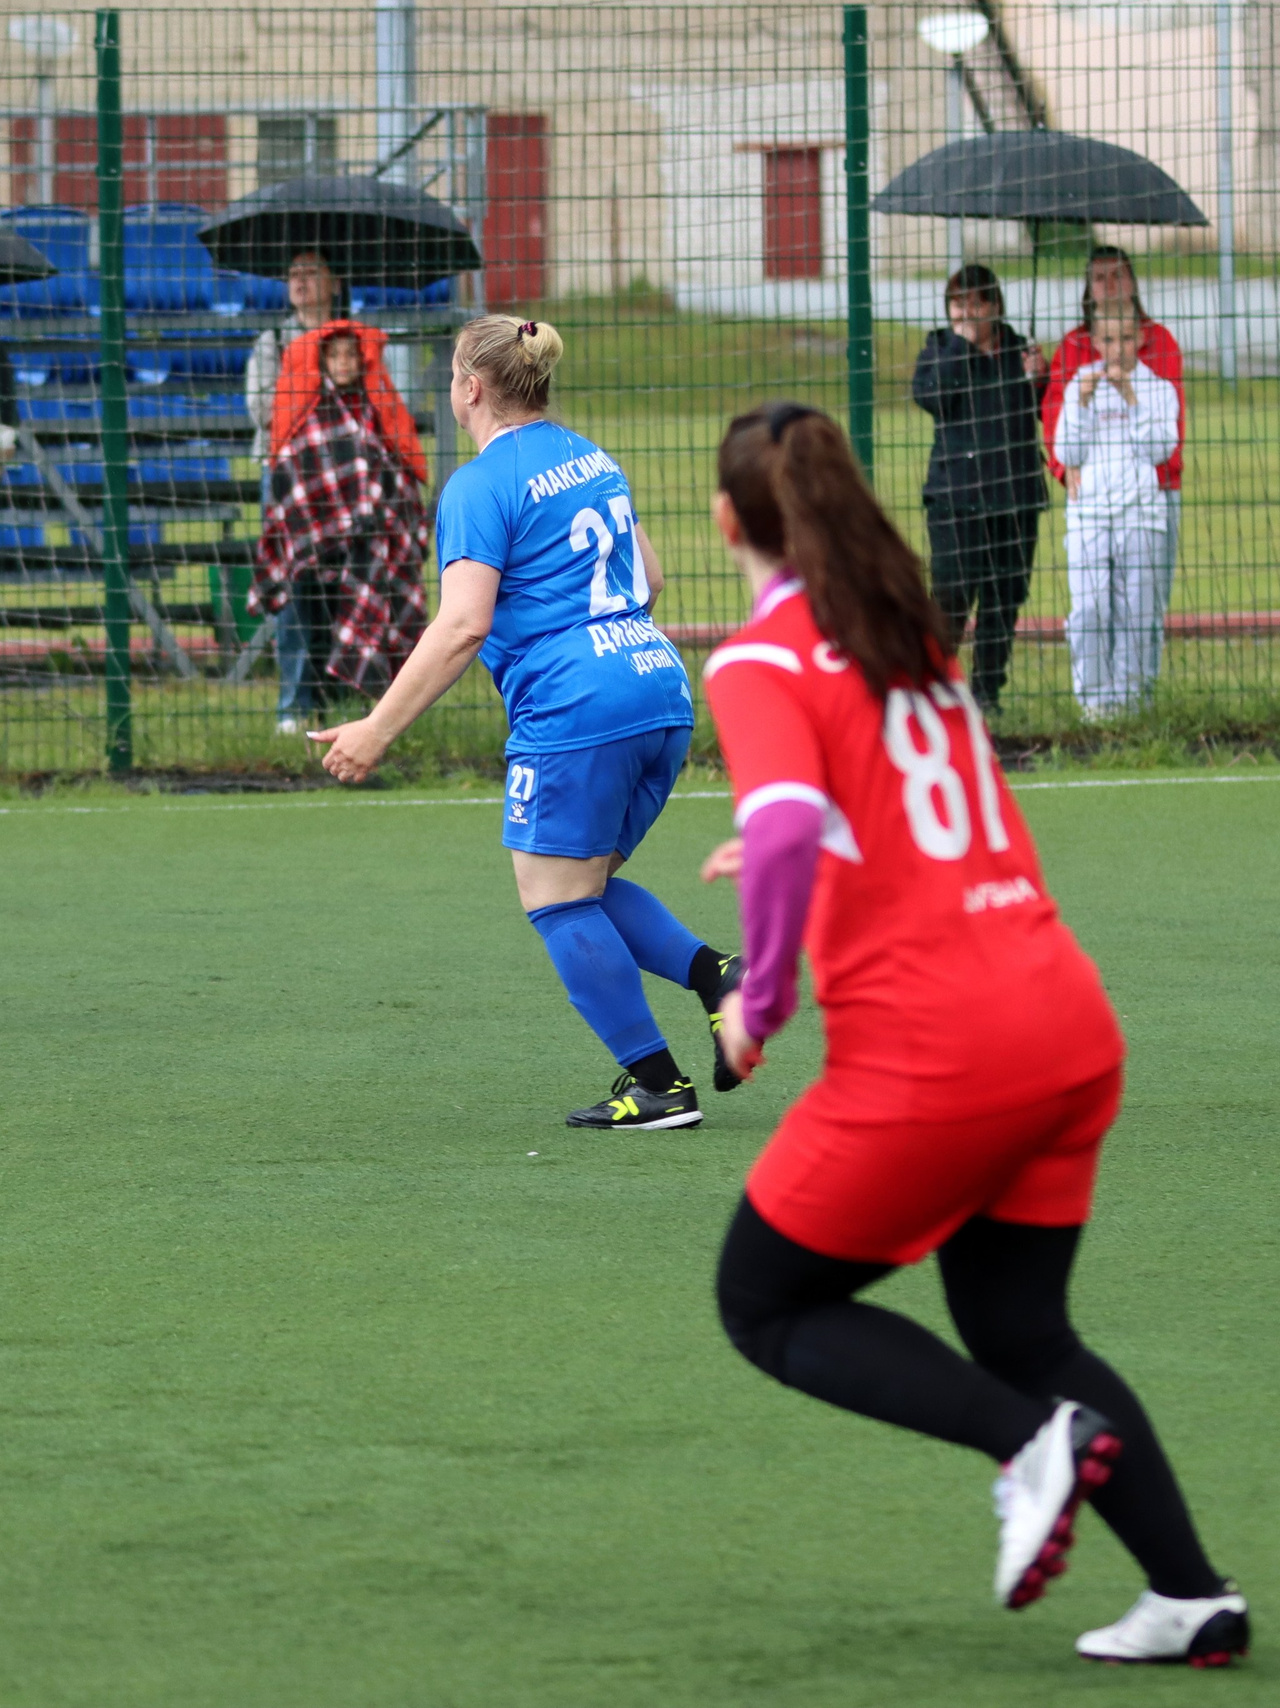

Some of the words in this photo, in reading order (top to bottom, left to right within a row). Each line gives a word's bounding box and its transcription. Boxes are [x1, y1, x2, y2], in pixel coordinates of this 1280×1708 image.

[569, 495, 651, 617] 27
[631, 649, 676, 676] ДУБНА
[508, 764, 535, 802] 27
[882, 679, 1011, 862] 87
